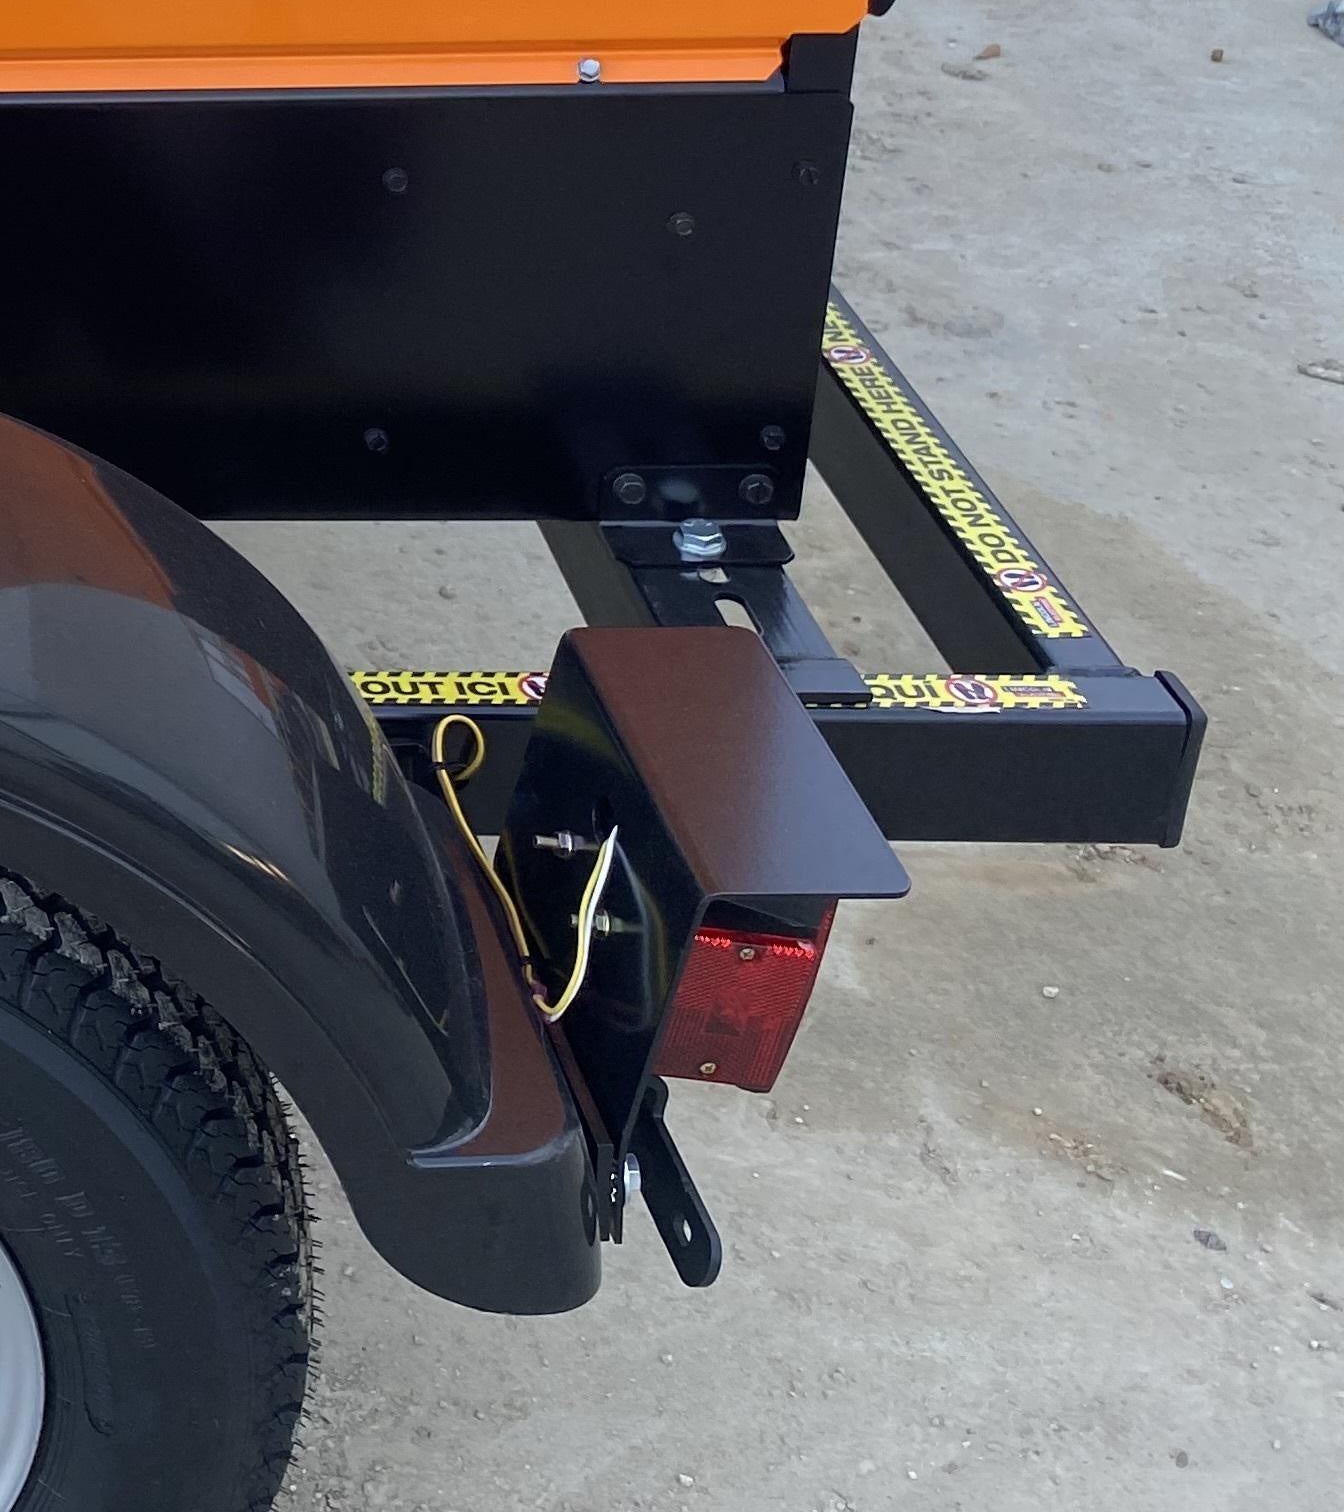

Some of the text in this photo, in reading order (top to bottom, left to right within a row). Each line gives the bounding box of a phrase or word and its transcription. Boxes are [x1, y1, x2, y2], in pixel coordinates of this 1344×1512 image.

[853, 366, 1019, 564] DO NOT STAND HERE
[455, 681, 510, 696] ICI
